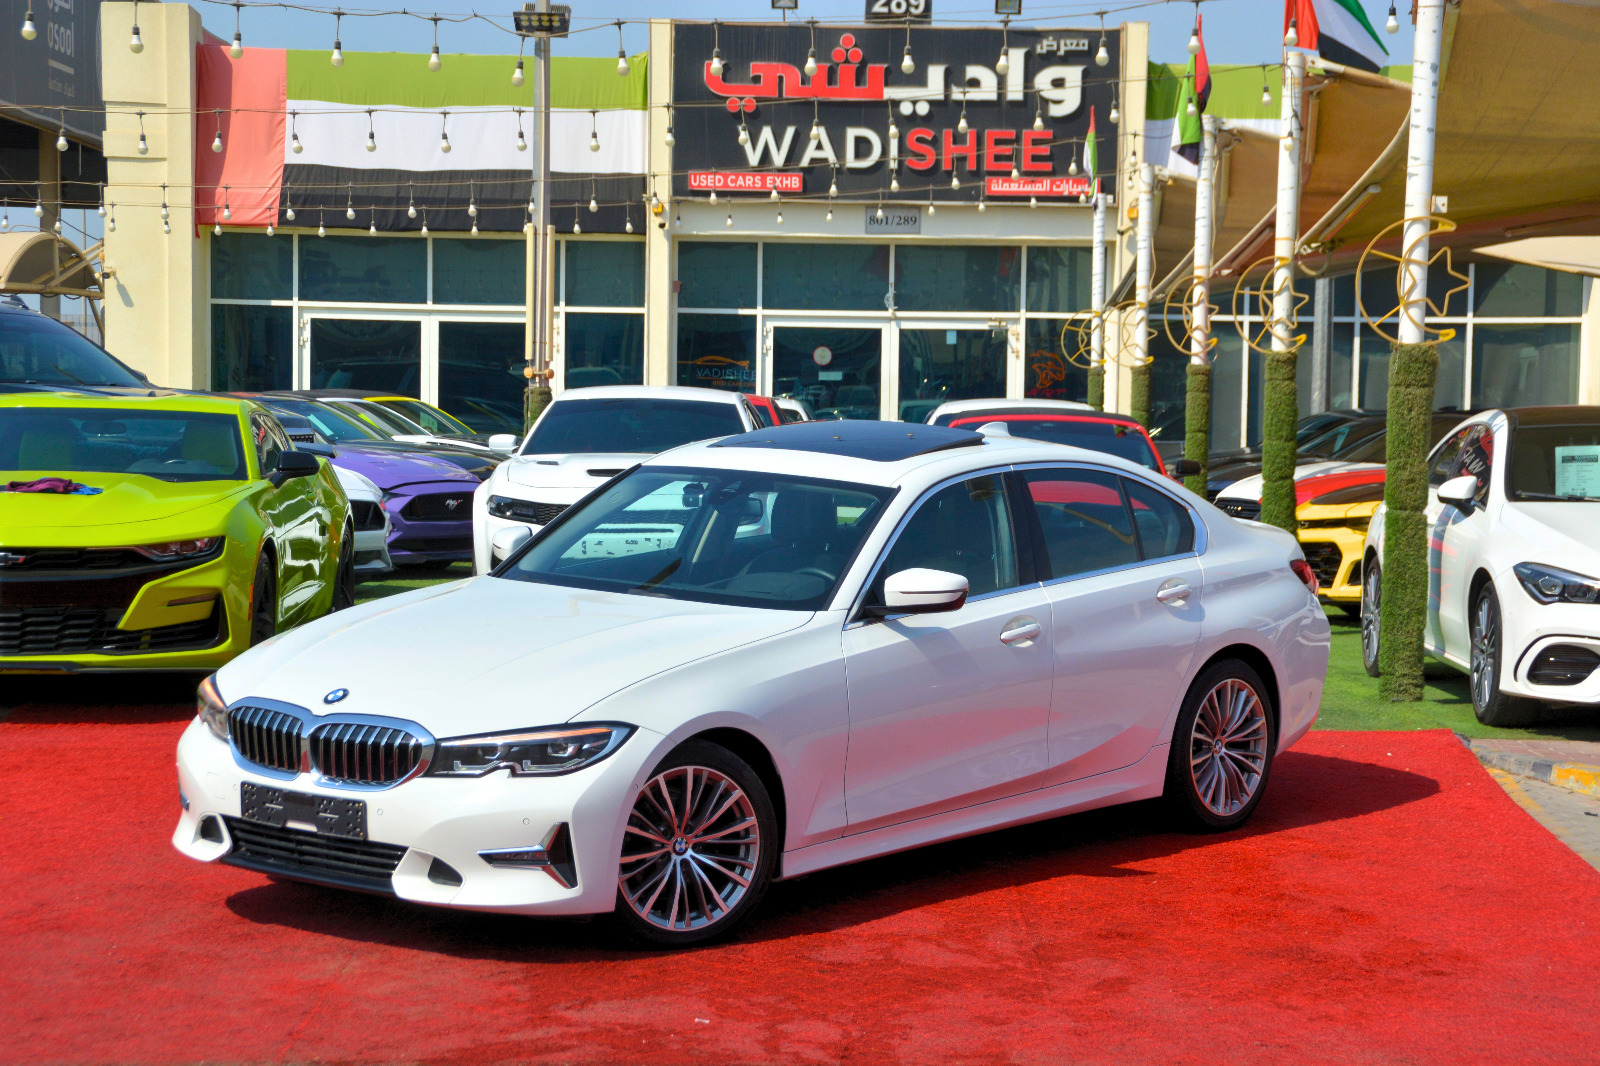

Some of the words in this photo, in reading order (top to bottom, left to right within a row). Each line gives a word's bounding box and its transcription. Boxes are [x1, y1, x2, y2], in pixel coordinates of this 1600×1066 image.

[1036, 37, 1088, 56] معرض
[691, 174, 724, 186] USED
[727, 175, 762, 185] CARS
[766, 176, 800, 188] EXHB
[991, 179, 1050, 191] المستعملة
[869, 215, 917, 226] 801/289
